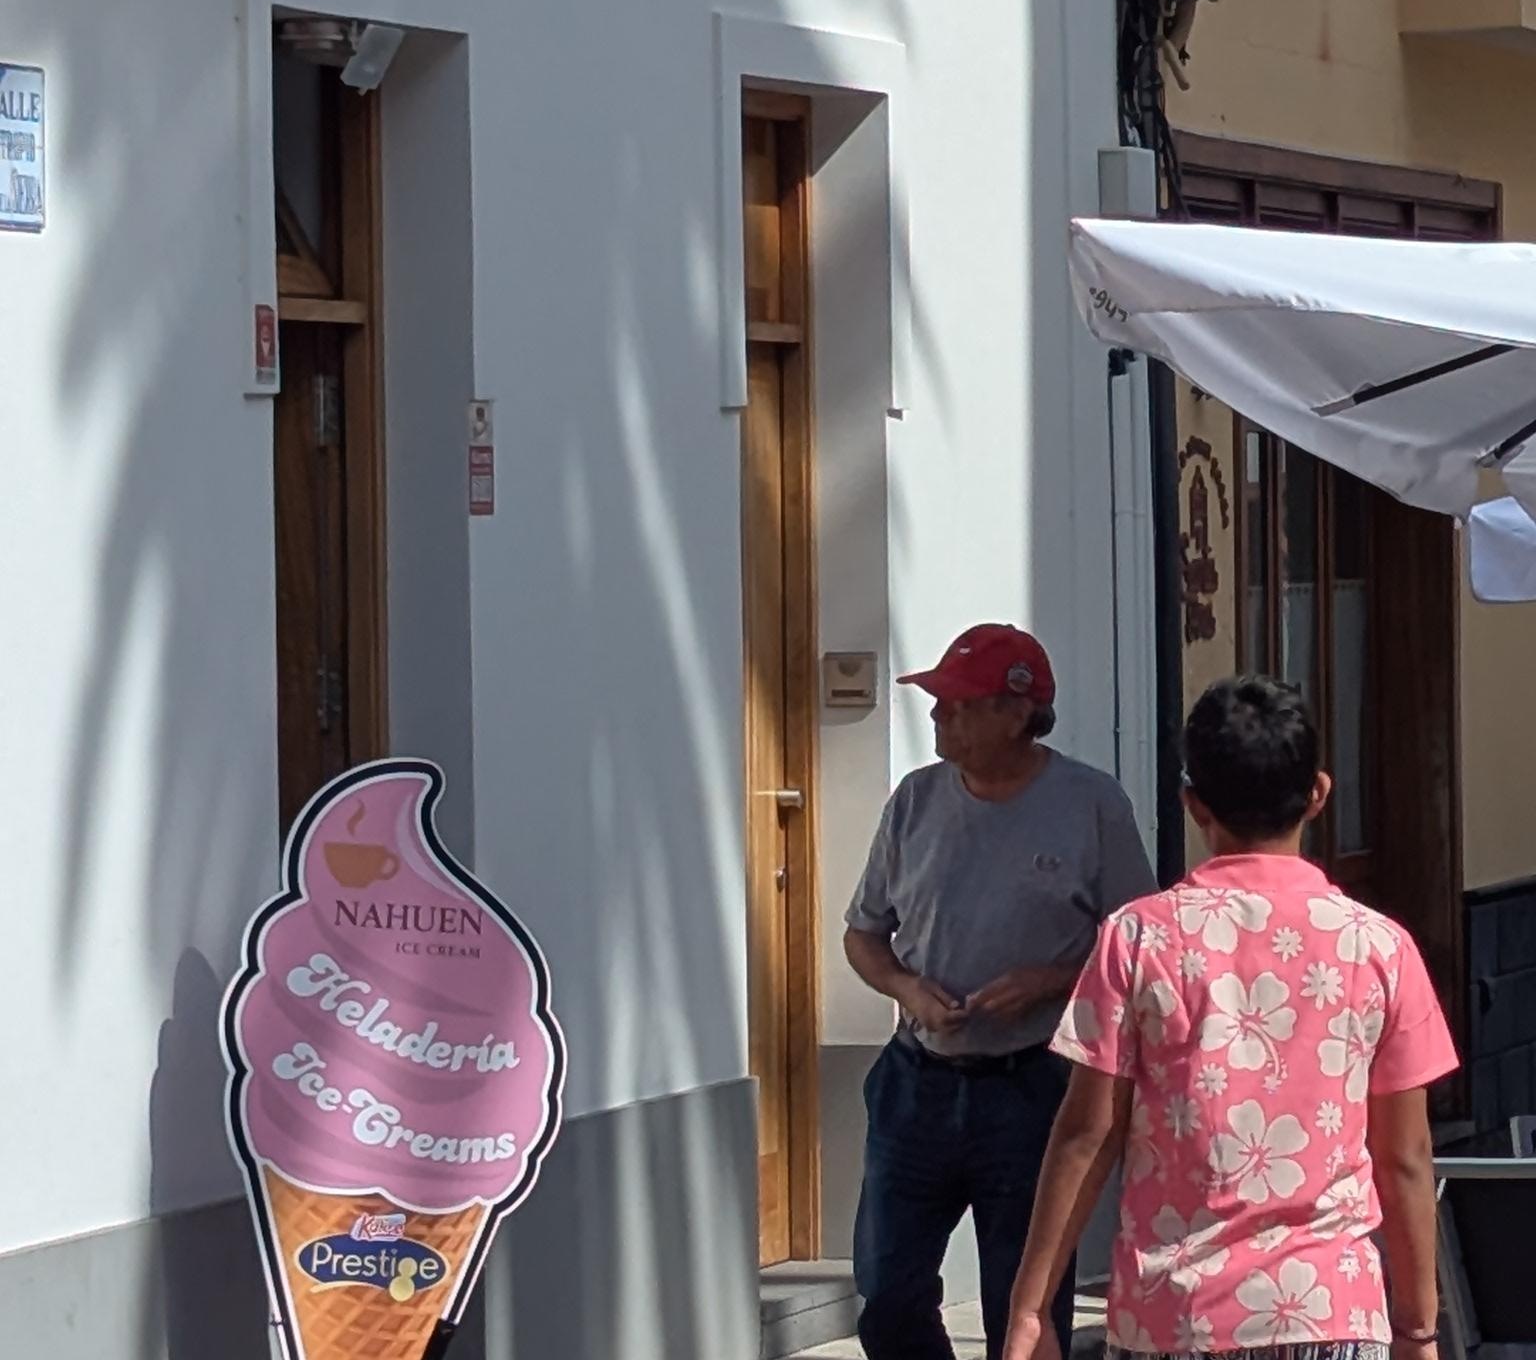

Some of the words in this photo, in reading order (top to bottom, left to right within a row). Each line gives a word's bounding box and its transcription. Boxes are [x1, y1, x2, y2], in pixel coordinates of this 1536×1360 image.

[0, 91, 41, 122] ALLE
[334, 899, 484, 936] NAHUEN
[395, 942, 419, 954] ICE
[426, 943, 481, 959] CREAM
[286, 953, 521, 1073] Heladería
[272, 1042, 516, 1164] Ice-Creams
